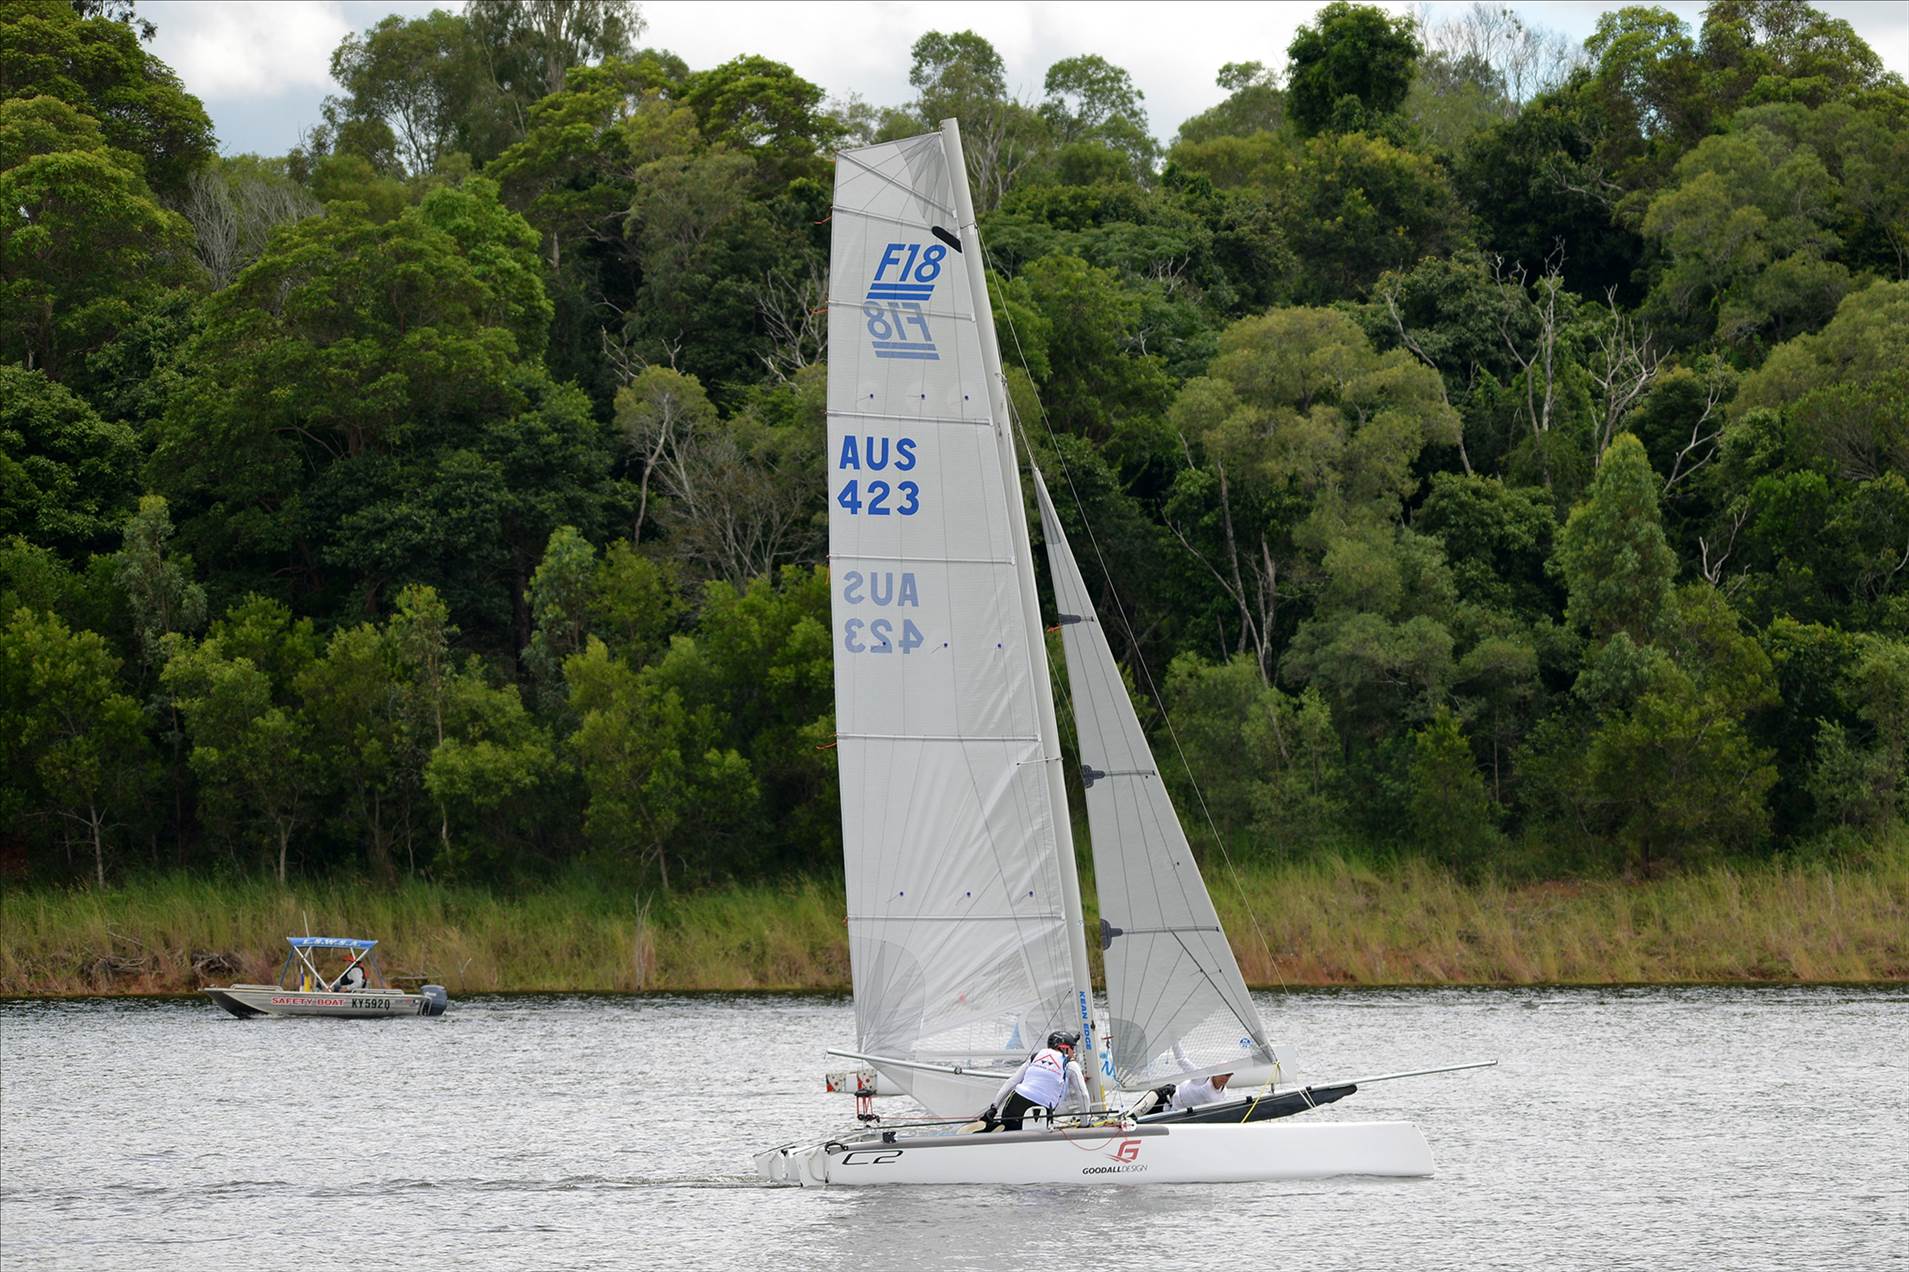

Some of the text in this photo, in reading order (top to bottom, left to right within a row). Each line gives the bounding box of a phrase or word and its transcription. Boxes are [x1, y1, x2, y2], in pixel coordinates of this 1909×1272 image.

[874, 243, 947, 283] F18
[839, 434, 918, 471] AUS
[837, 479, 920, 516] 423
[272, 997, 344, 1007] SAFETY BOAT
[352, 998, 391, 1010] KY592Q
[1079, 991, 1092, 1050] KEAN EDGE
[842, 1150, 903, 1165] C2
